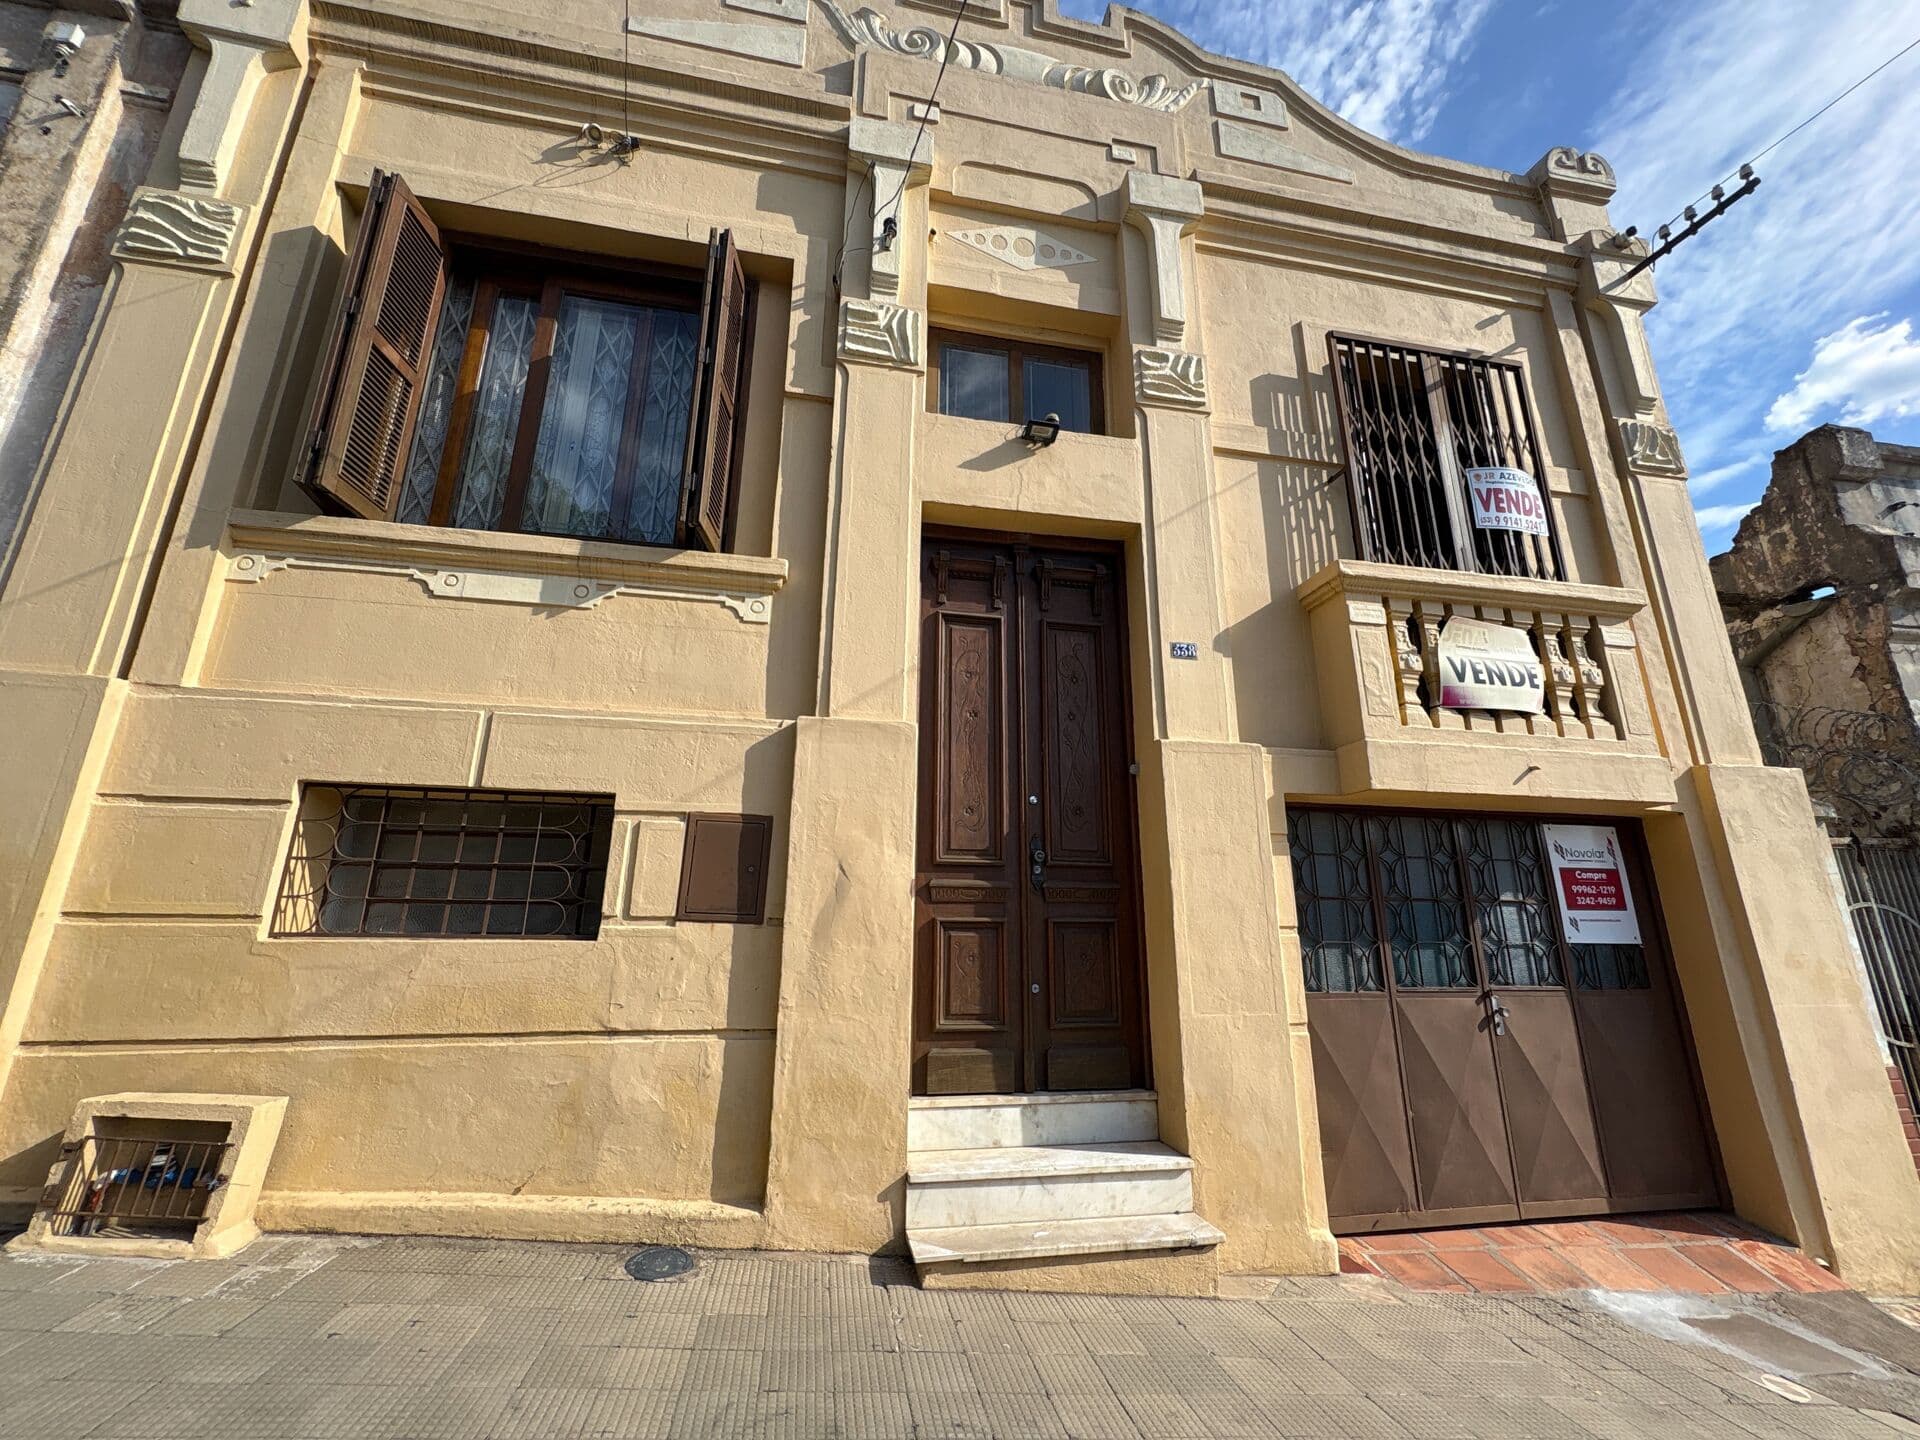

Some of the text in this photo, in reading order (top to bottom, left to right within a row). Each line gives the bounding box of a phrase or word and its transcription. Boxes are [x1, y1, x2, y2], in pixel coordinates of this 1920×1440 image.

[1484, 472, 1495, 480] JR
[1474, 487, 1543, 519] VENDE
[1494, 515, 1501, 525] 9
[1446, 656, 1540, 689] VENDE
[1565, 848, 1605, 859] Novolar
[1575, 870, 1607, 880] Compre
